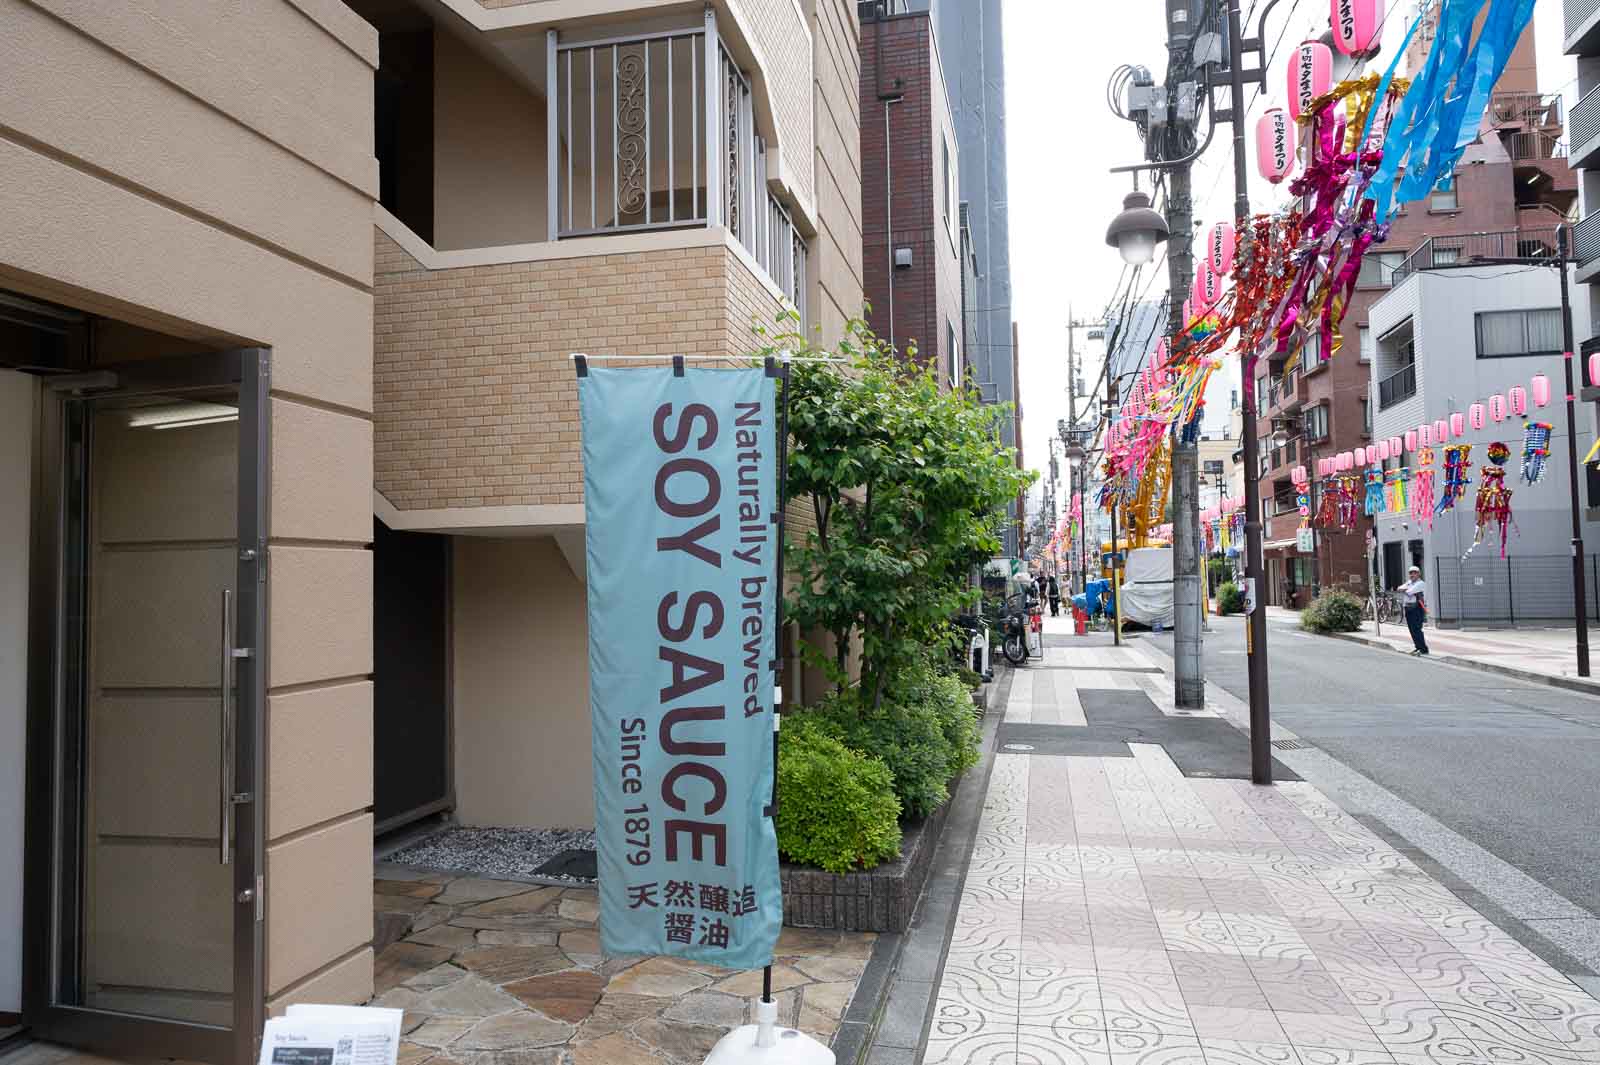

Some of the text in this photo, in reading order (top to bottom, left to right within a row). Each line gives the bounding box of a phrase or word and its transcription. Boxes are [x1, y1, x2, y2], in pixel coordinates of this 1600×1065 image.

[1274, 114, 1286, 170] 下町七夕まつり
[652, 402, 727, 867] SOY SAUCE
[732, 402, 767, 718] Naturally brewed
[620, 717, 651, 866] Since 1879
[664, 912, 729, 949] 醤油
